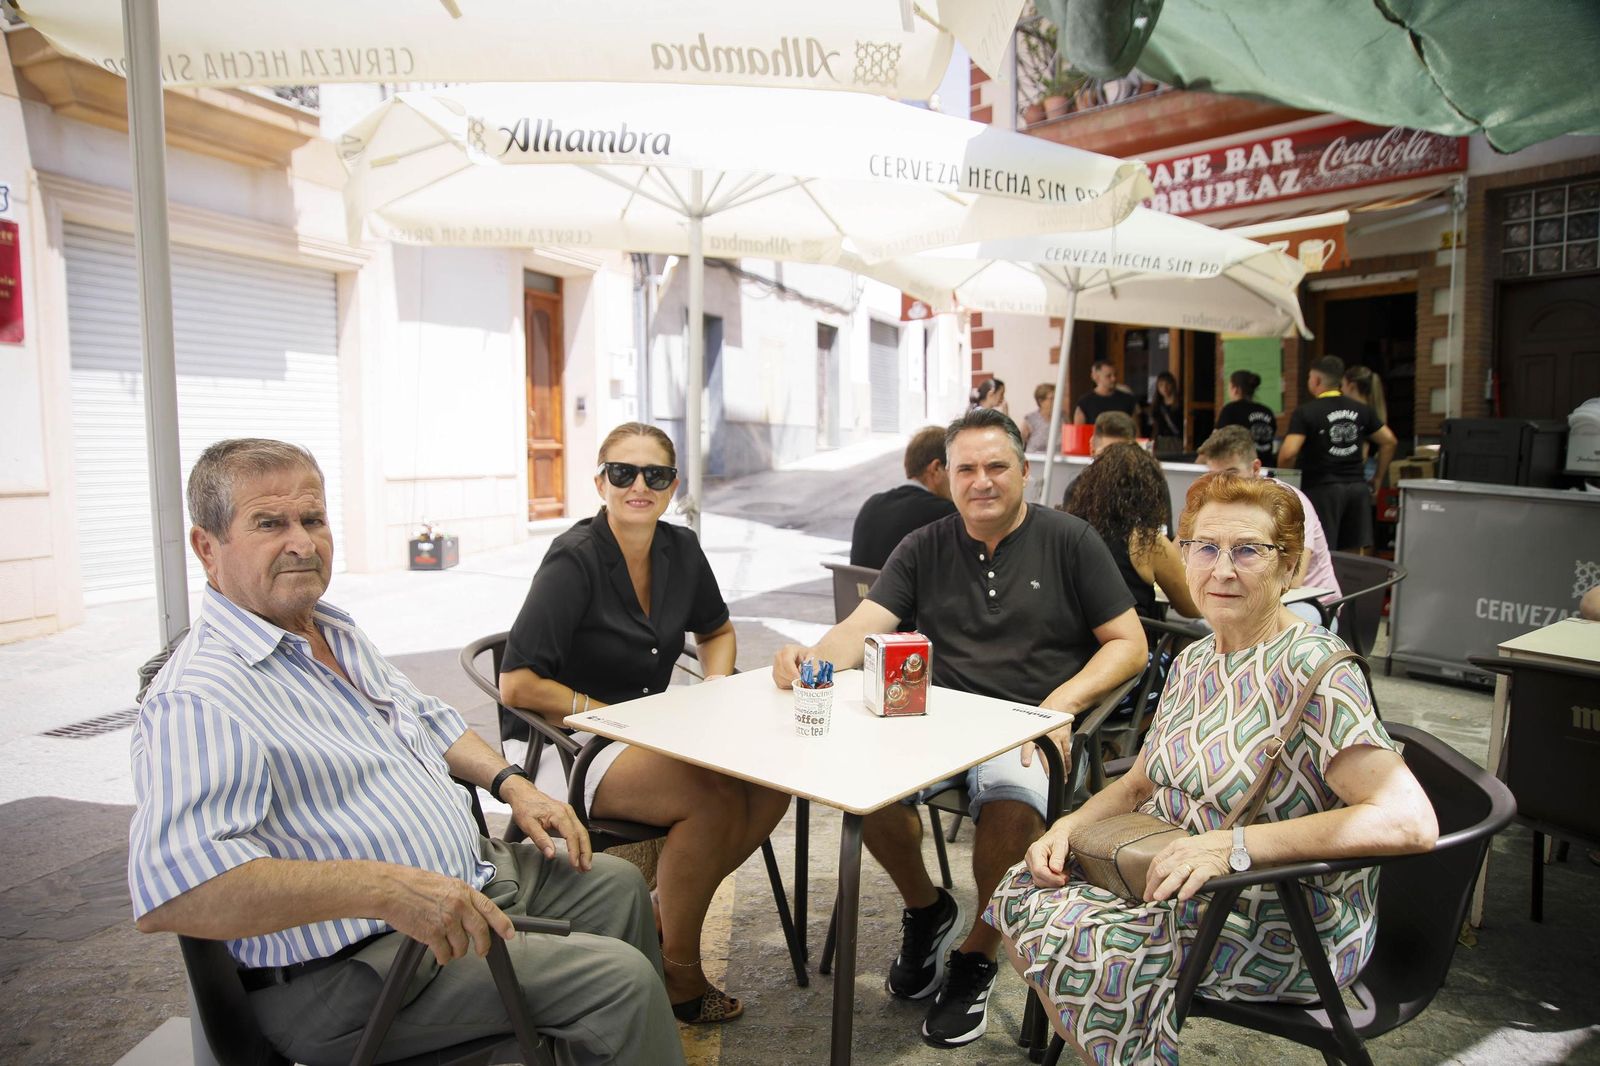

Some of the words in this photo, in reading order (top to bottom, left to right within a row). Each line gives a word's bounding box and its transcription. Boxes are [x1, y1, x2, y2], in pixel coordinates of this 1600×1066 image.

[498, 117, 671, 156] Alhambra
[869, 154, 960, 185] CERVEZA
[968, 165, 1031, 196] HECHA
[1037, 178, 1067, 202] SIN
[1147, 154, 1212, 187] AFE
[1223, 137, 1296, 174] BAR
[1150, 168, 1301, 214] BRUPLAZ
[1045, 246, 1107, 264] CERVEZA
[1112, 253, 1161, 270] HECHA
[1168, 256, 1192, 273] SIN
[811, 726, 823, 736] tea
